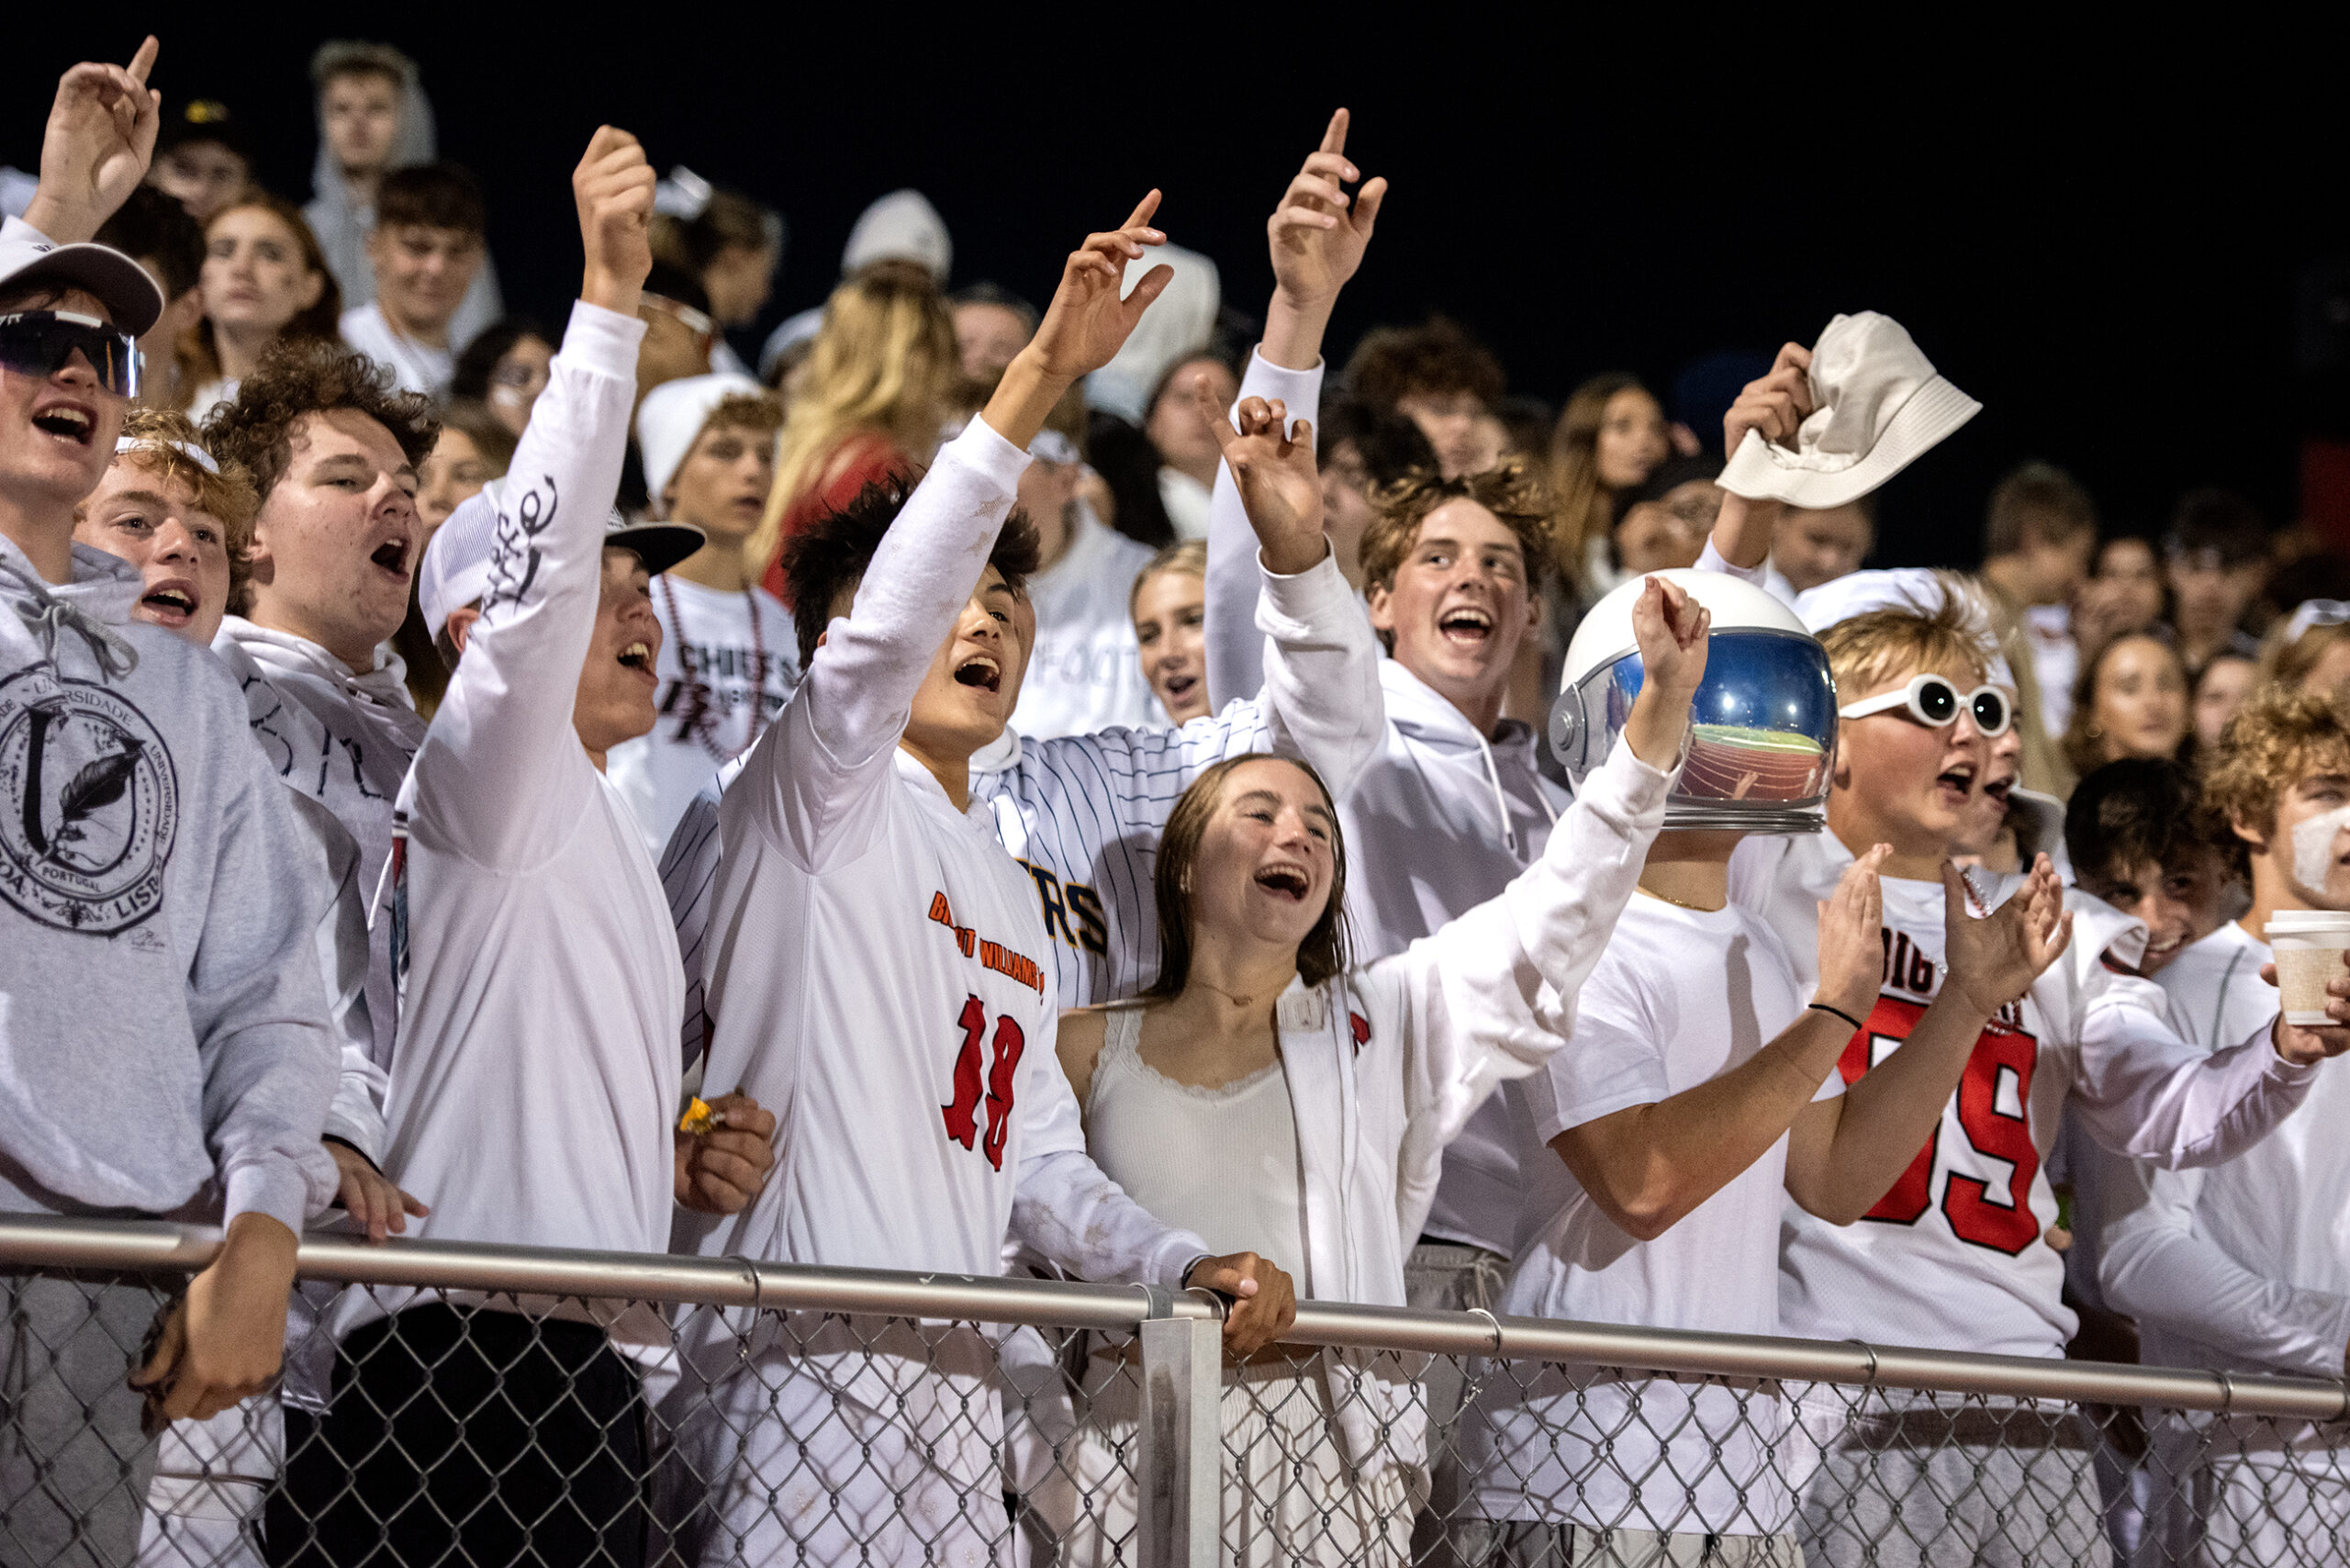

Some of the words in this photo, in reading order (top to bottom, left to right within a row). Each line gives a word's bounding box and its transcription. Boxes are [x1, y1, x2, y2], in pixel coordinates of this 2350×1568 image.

[41, 866, 102, 893] PORTUGAL
[1014, 857, 1109, 959] RS
[941, 993, 1025, 1172] 18
